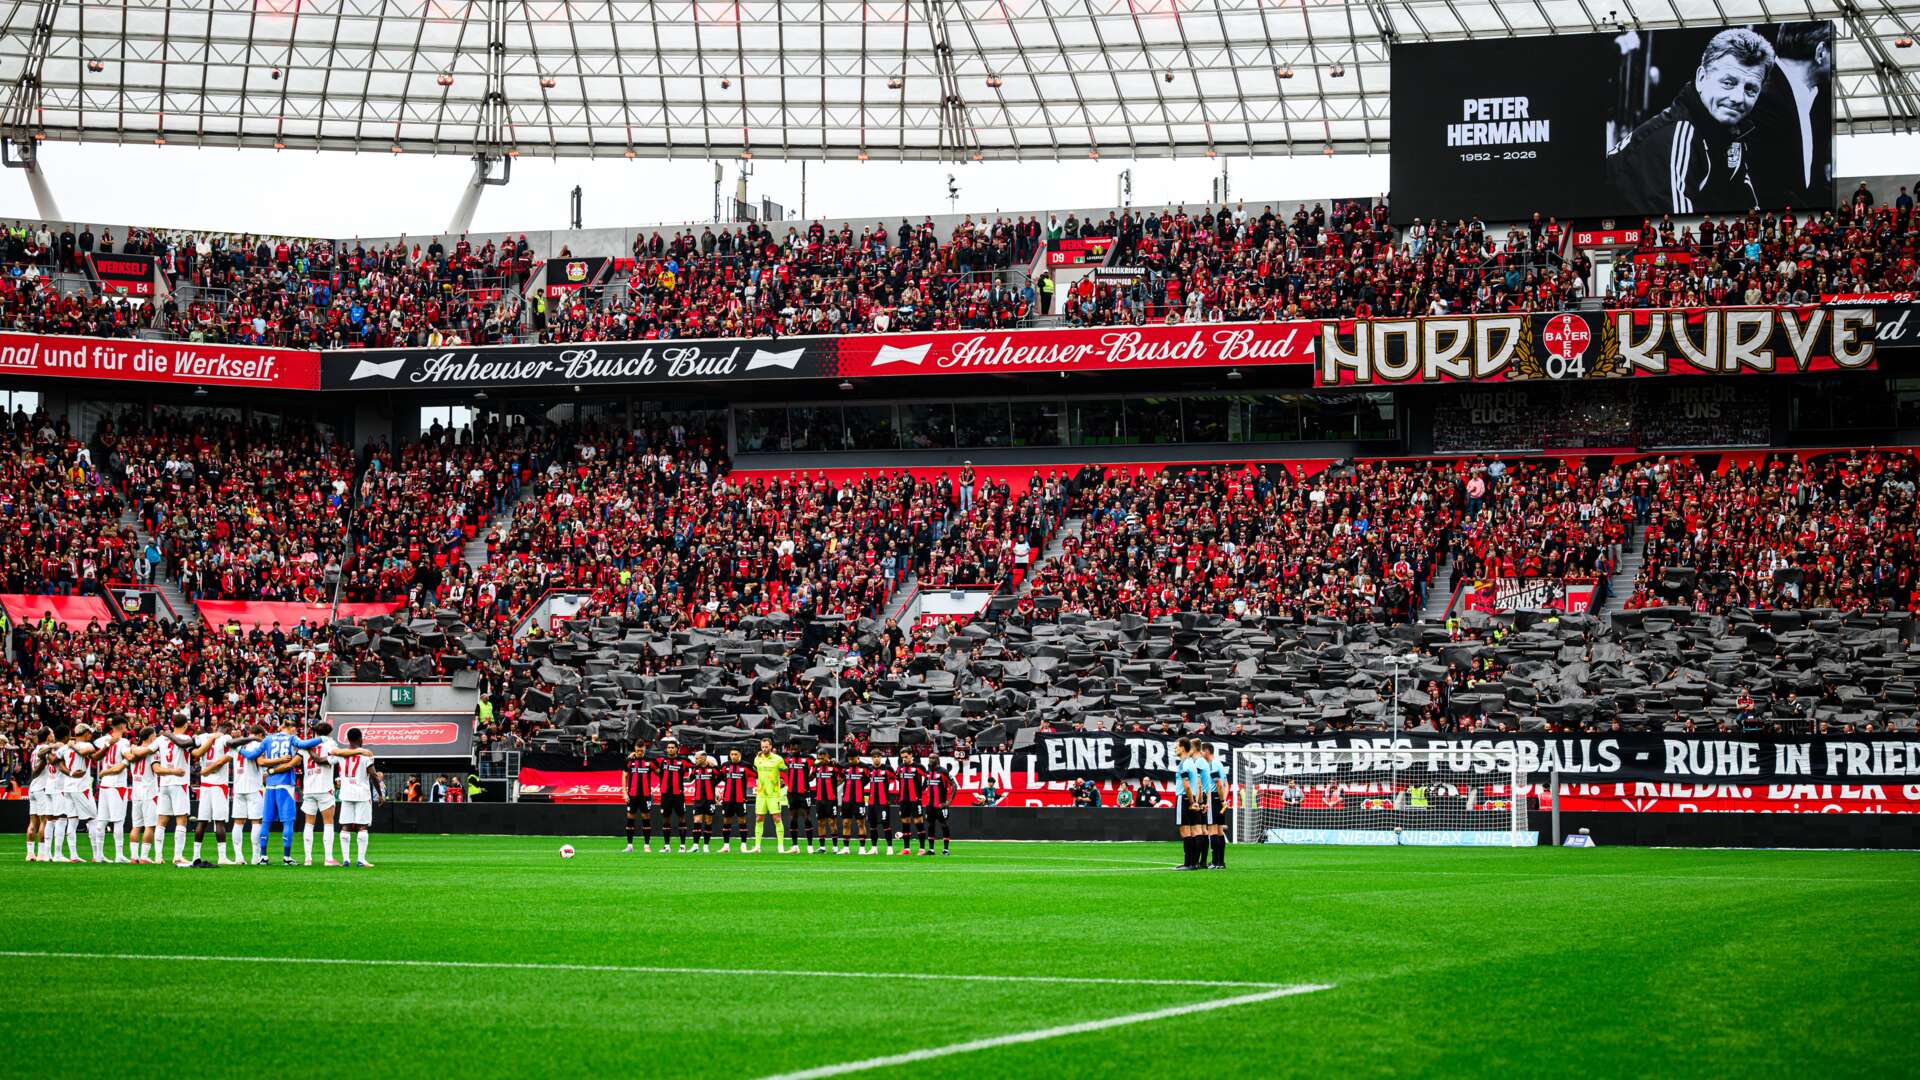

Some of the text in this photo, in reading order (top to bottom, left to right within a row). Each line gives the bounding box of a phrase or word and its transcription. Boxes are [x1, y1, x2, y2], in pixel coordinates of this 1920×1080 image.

[1464, 97, 1529, 121] PETER
[1447, 120, 1550, 147] HERMANN
[1460, 153, 1491, 162] 1952
[1503, 151, 1537, 160] 2026
[1579, 231, 1639, 244] D8 D8
[97, 260, 148, 275] WERKSELF
[1052, 253, 1065, 263] D9
[136, 283, 148, 293] E4
[1826, 295, 1889, 306] Leverkusen
[1545, 332, 1588, 341] BAYER
[1616, 308, 1876, 372] KURVE
[937, 328, 1298, 368] Anheuser-Busch Bud
[44, 346, 86, 369] und
[93, 346, 127, 371] für
[133, 349, 167, 372] die
[173, 351, 279, 379] Werkself.
[410, 346, 740, 383] Anheuser-Busch Bud
[1546, 353, 1586, 379] 04
[926, 616, 938, 626] D4
[344, 754, 361, 777] 17
[1045, 738, 1117, 771] EINE
[1124, 738, 1230, 773] TREE
[1242, 739, 1338, 775] SEELE
[1350, 738, 1413, 772] DES
[1428, 739, 1622, 773] FUSSBALLS
[1663, 739, 1760, 775] RUHE
[1774, 743, 1812, 775] IN
[1402, 831, 1463, 844] NIEDAX
